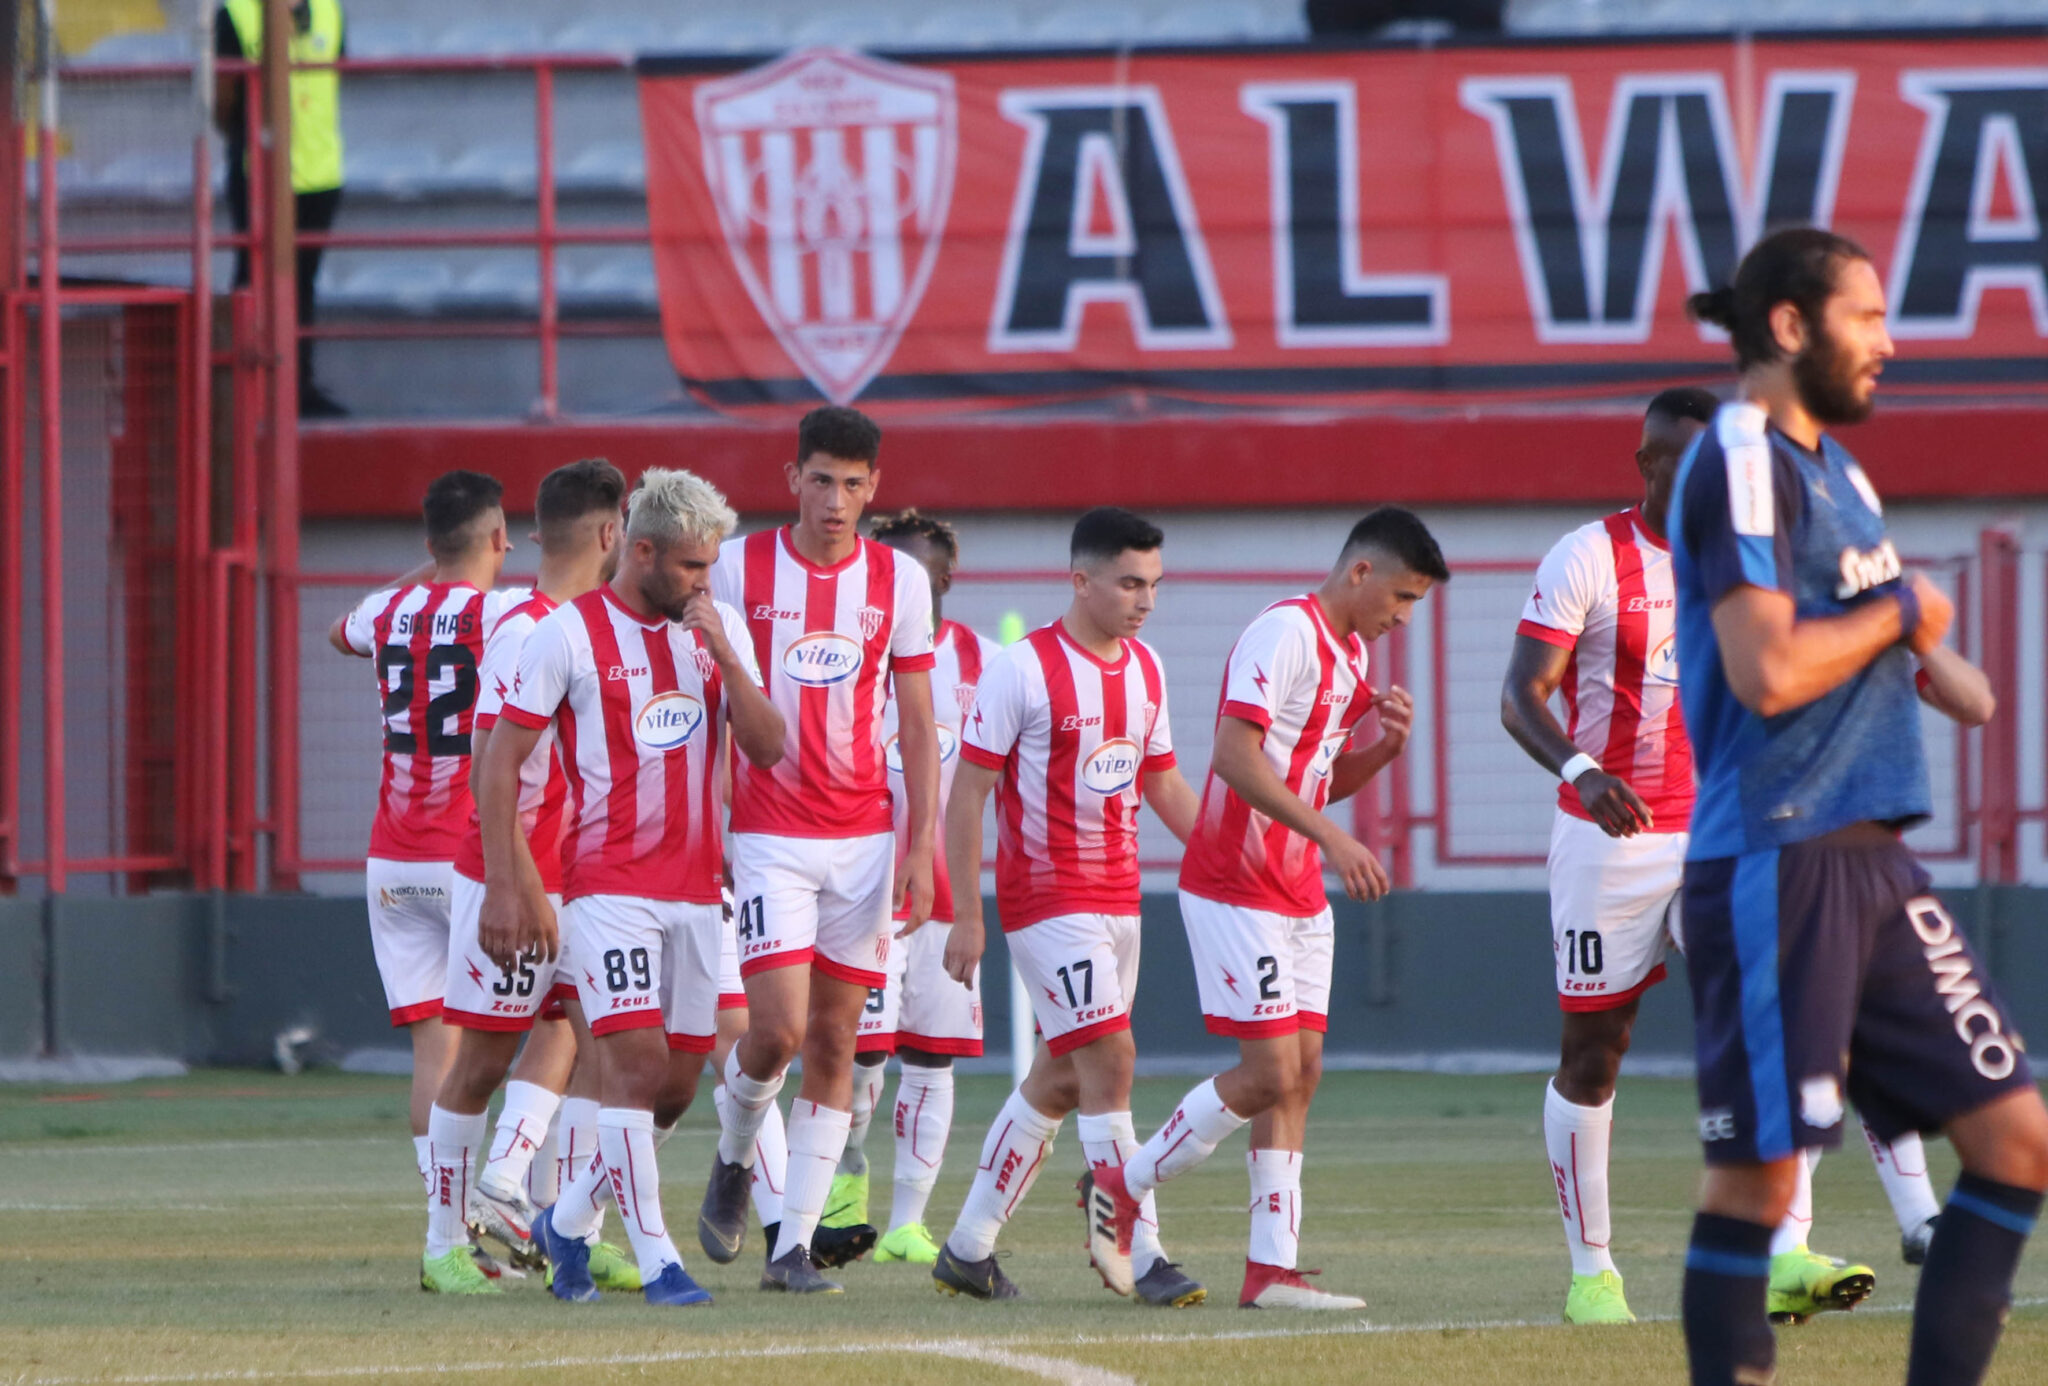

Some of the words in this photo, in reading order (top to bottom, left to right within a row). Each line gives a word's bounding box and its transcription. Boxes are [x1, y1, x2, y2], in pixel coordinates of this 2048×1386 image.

[753, 605, 802, 621] Zeus
[1627, 597, 1673, 612] Zeus
[398, 613, 476, 636] SIATHAS
[794, 645, 852, 668] vitex
[608, 666, 648, 680] Zeus
[379, 644, 478, 755] 22
[1320, 690, 1349, 705] Zeus
[645, 708, 693, 729] vitex
[1060, 715, 1101, 731] Zeus
[1093, 755, 1135, 774] vitex
[739, 895, 765, 941] 41
[744, 938, 782, 956] Zeus
[1565, 929, 1603, 975] 10
[492, 951, 535, 997] 35
[604, 947, 651, 992] 89
[1257, 956, 1280, 1000] 2
[1057, 959, 1093, 1009] 17
[1564, 979, 1607, 991] Zeus
[1905, 895, 2016, 1081] DIMCO
[490, 1001, 529, 1013] Zeus
[610, 996, 651, 1009] Zeus
[1076, 1004, 1114, 1023] Zeus
[1252, 1002, 1291, 1016] Zeus
[995, 1148, 1023, 1194] Zeus
[440, 1166, 454, 1207] Zeus
[609, 1166, 630, 1218] Zeus
[1553, 1160, 1572, 1221] Zeus
